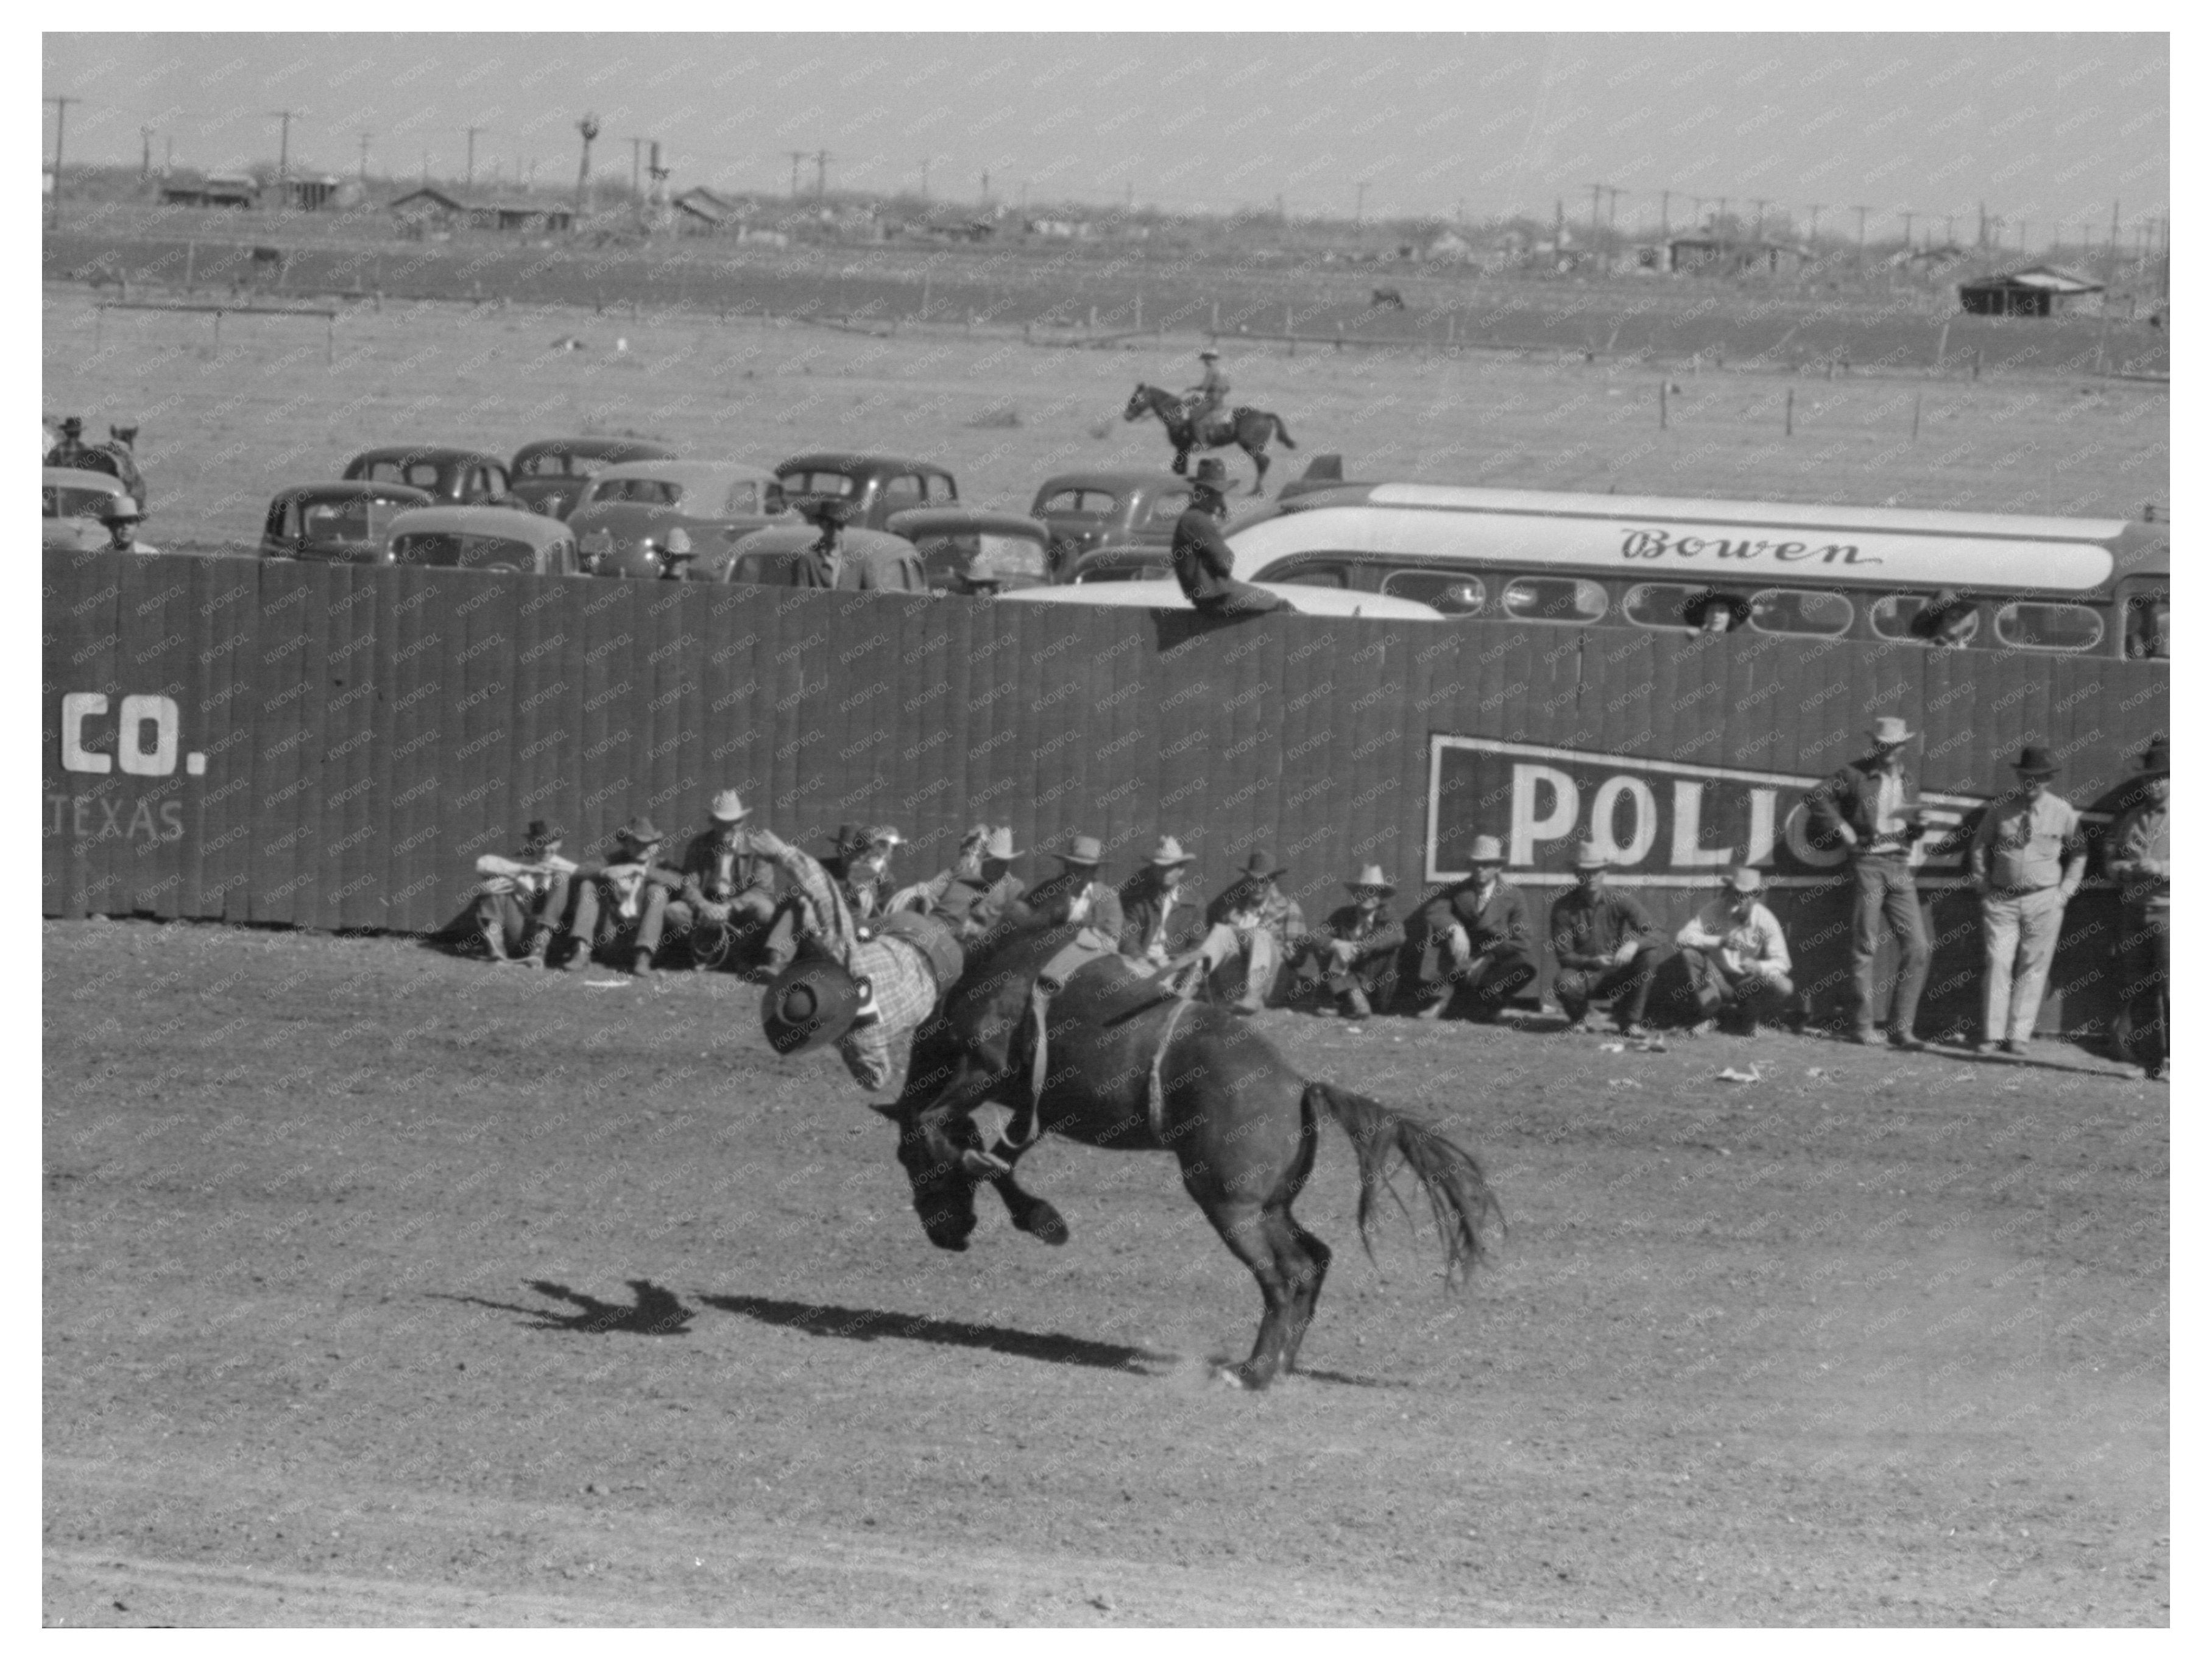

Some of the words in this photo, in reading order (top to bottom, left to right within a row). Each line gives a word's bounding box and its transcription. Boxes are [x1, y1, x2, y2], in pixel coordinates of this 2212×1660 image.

[1621, 529, 1883, 565] Bowen
[62, 692, 206, 776] CO.
[46, 794, 182, 841] TEXAS
